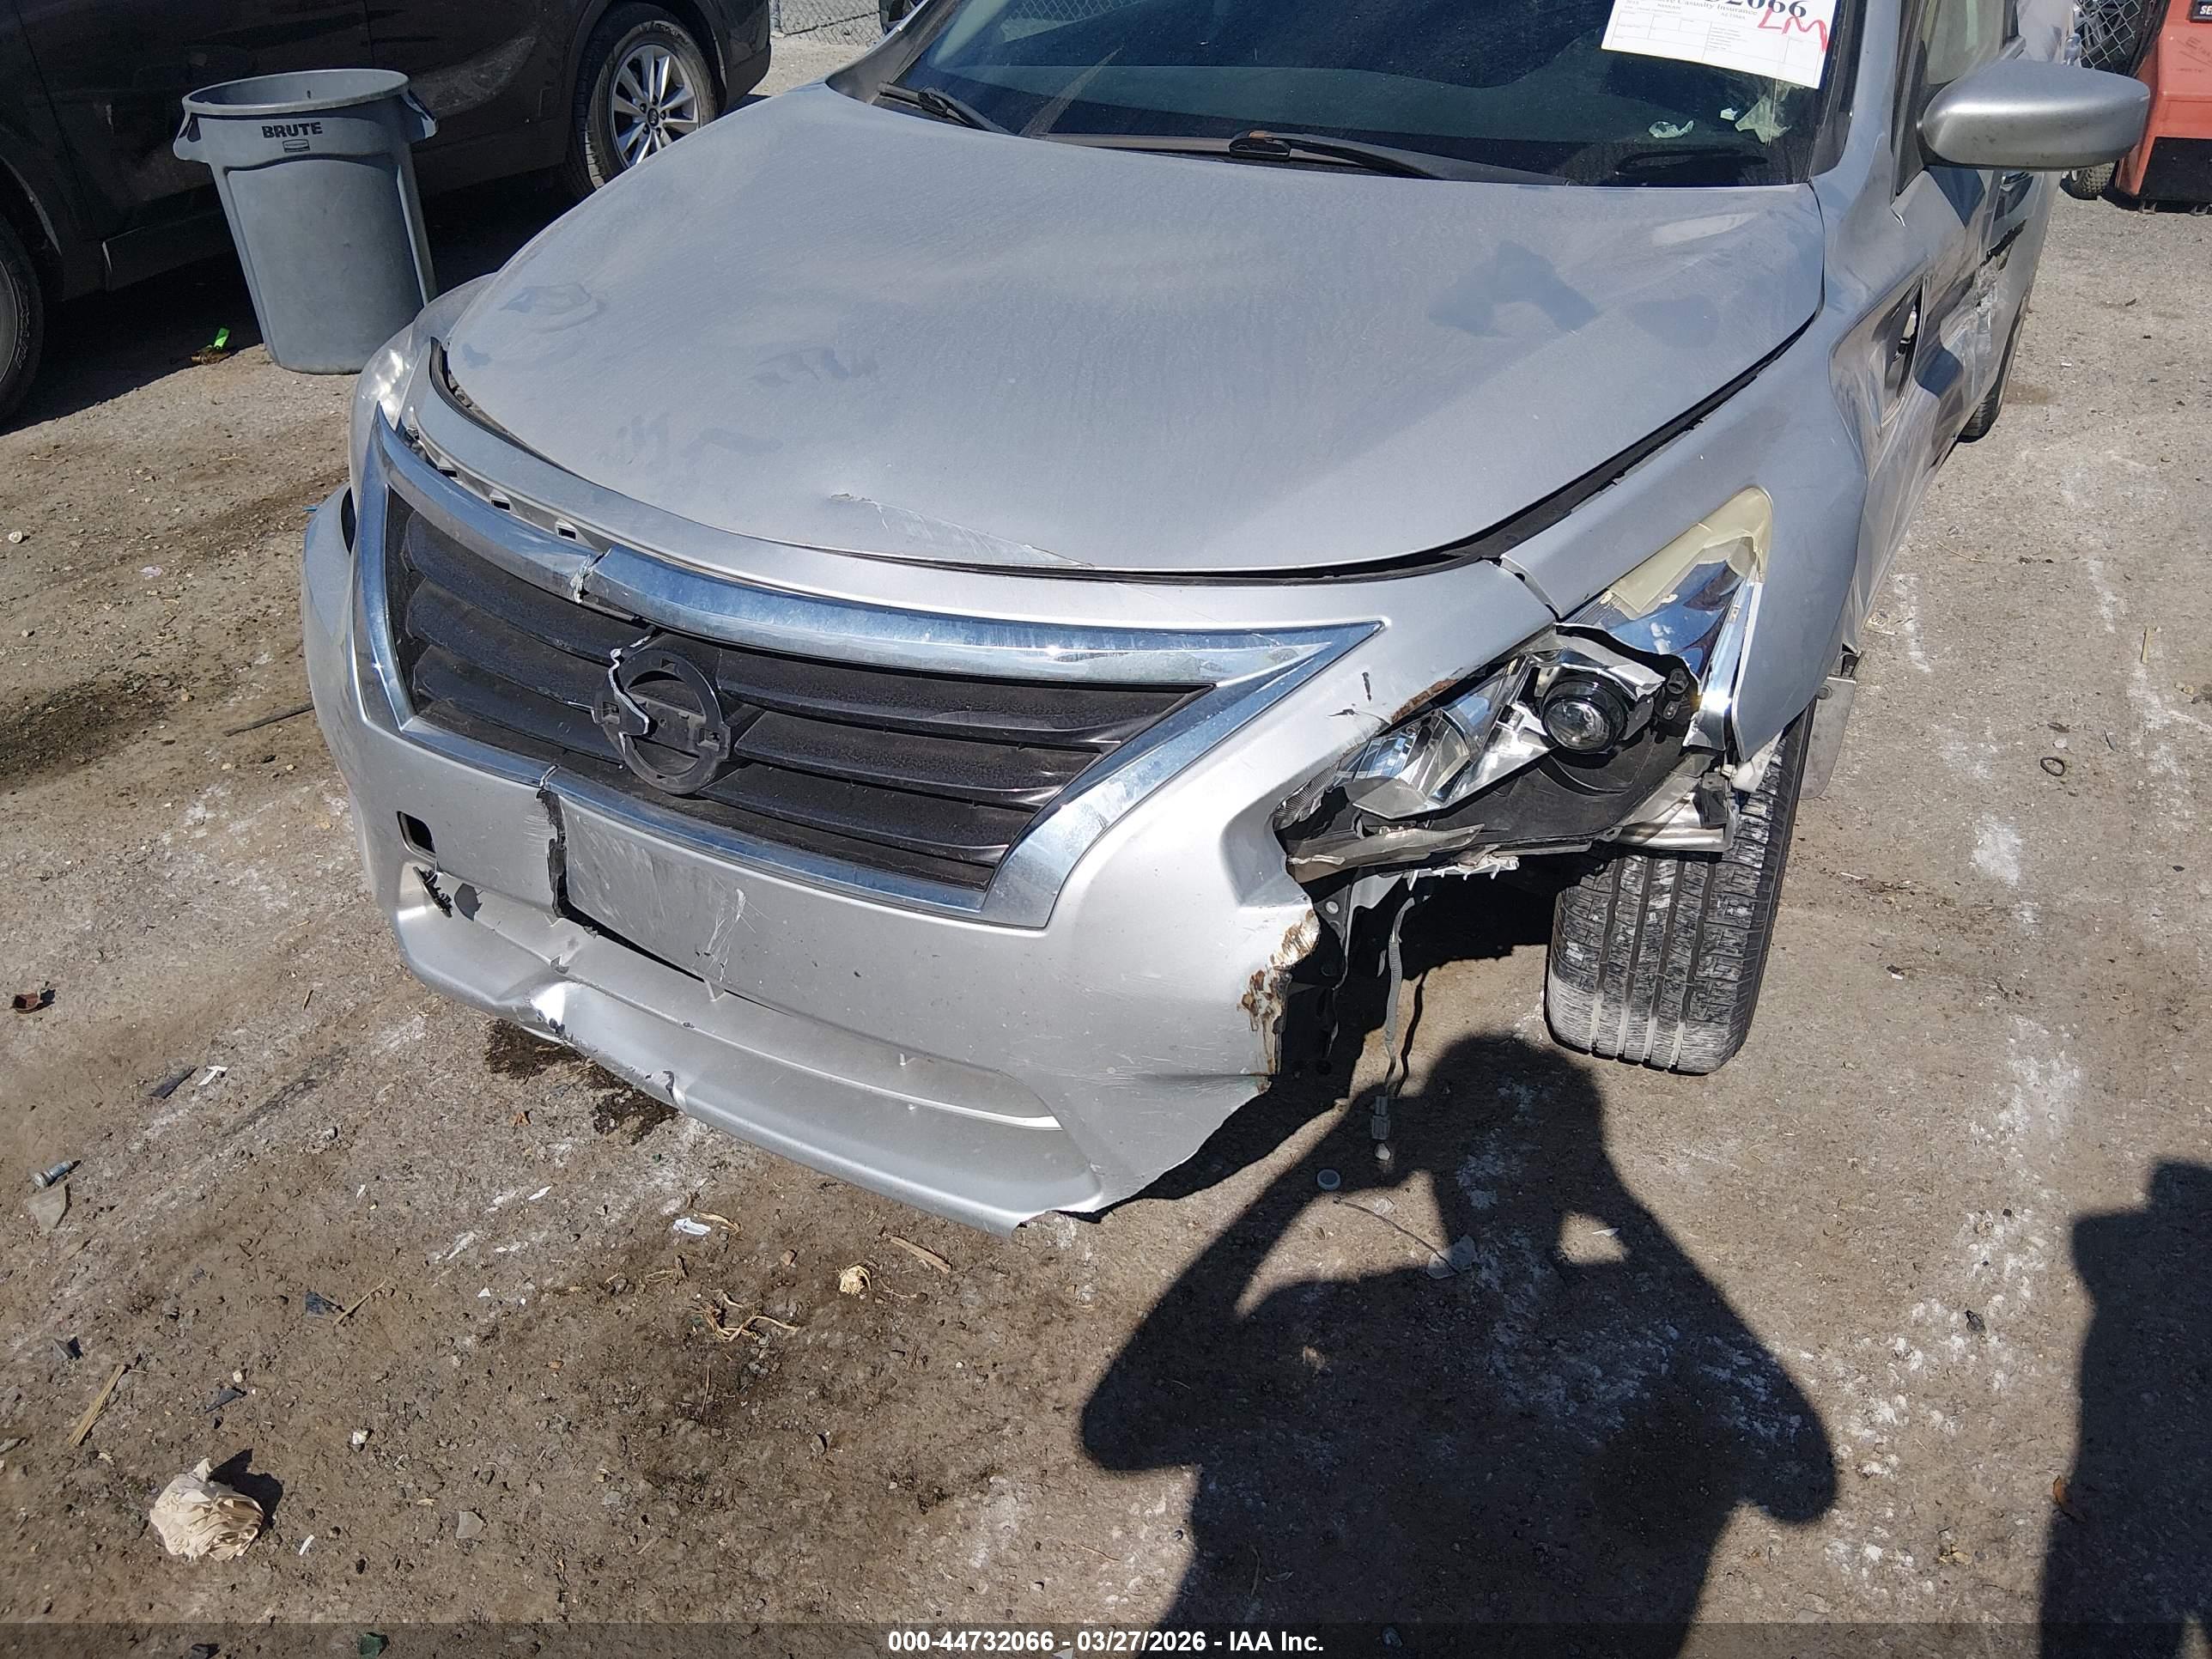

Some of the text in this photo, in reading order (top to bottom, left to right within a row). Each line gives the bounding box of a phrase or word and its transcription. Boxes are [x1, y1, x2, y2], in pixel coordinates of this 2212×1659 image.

[1678, 0, 1758, 15] Casualty Insurance
[261, 121, 323, 138] BRUTE
